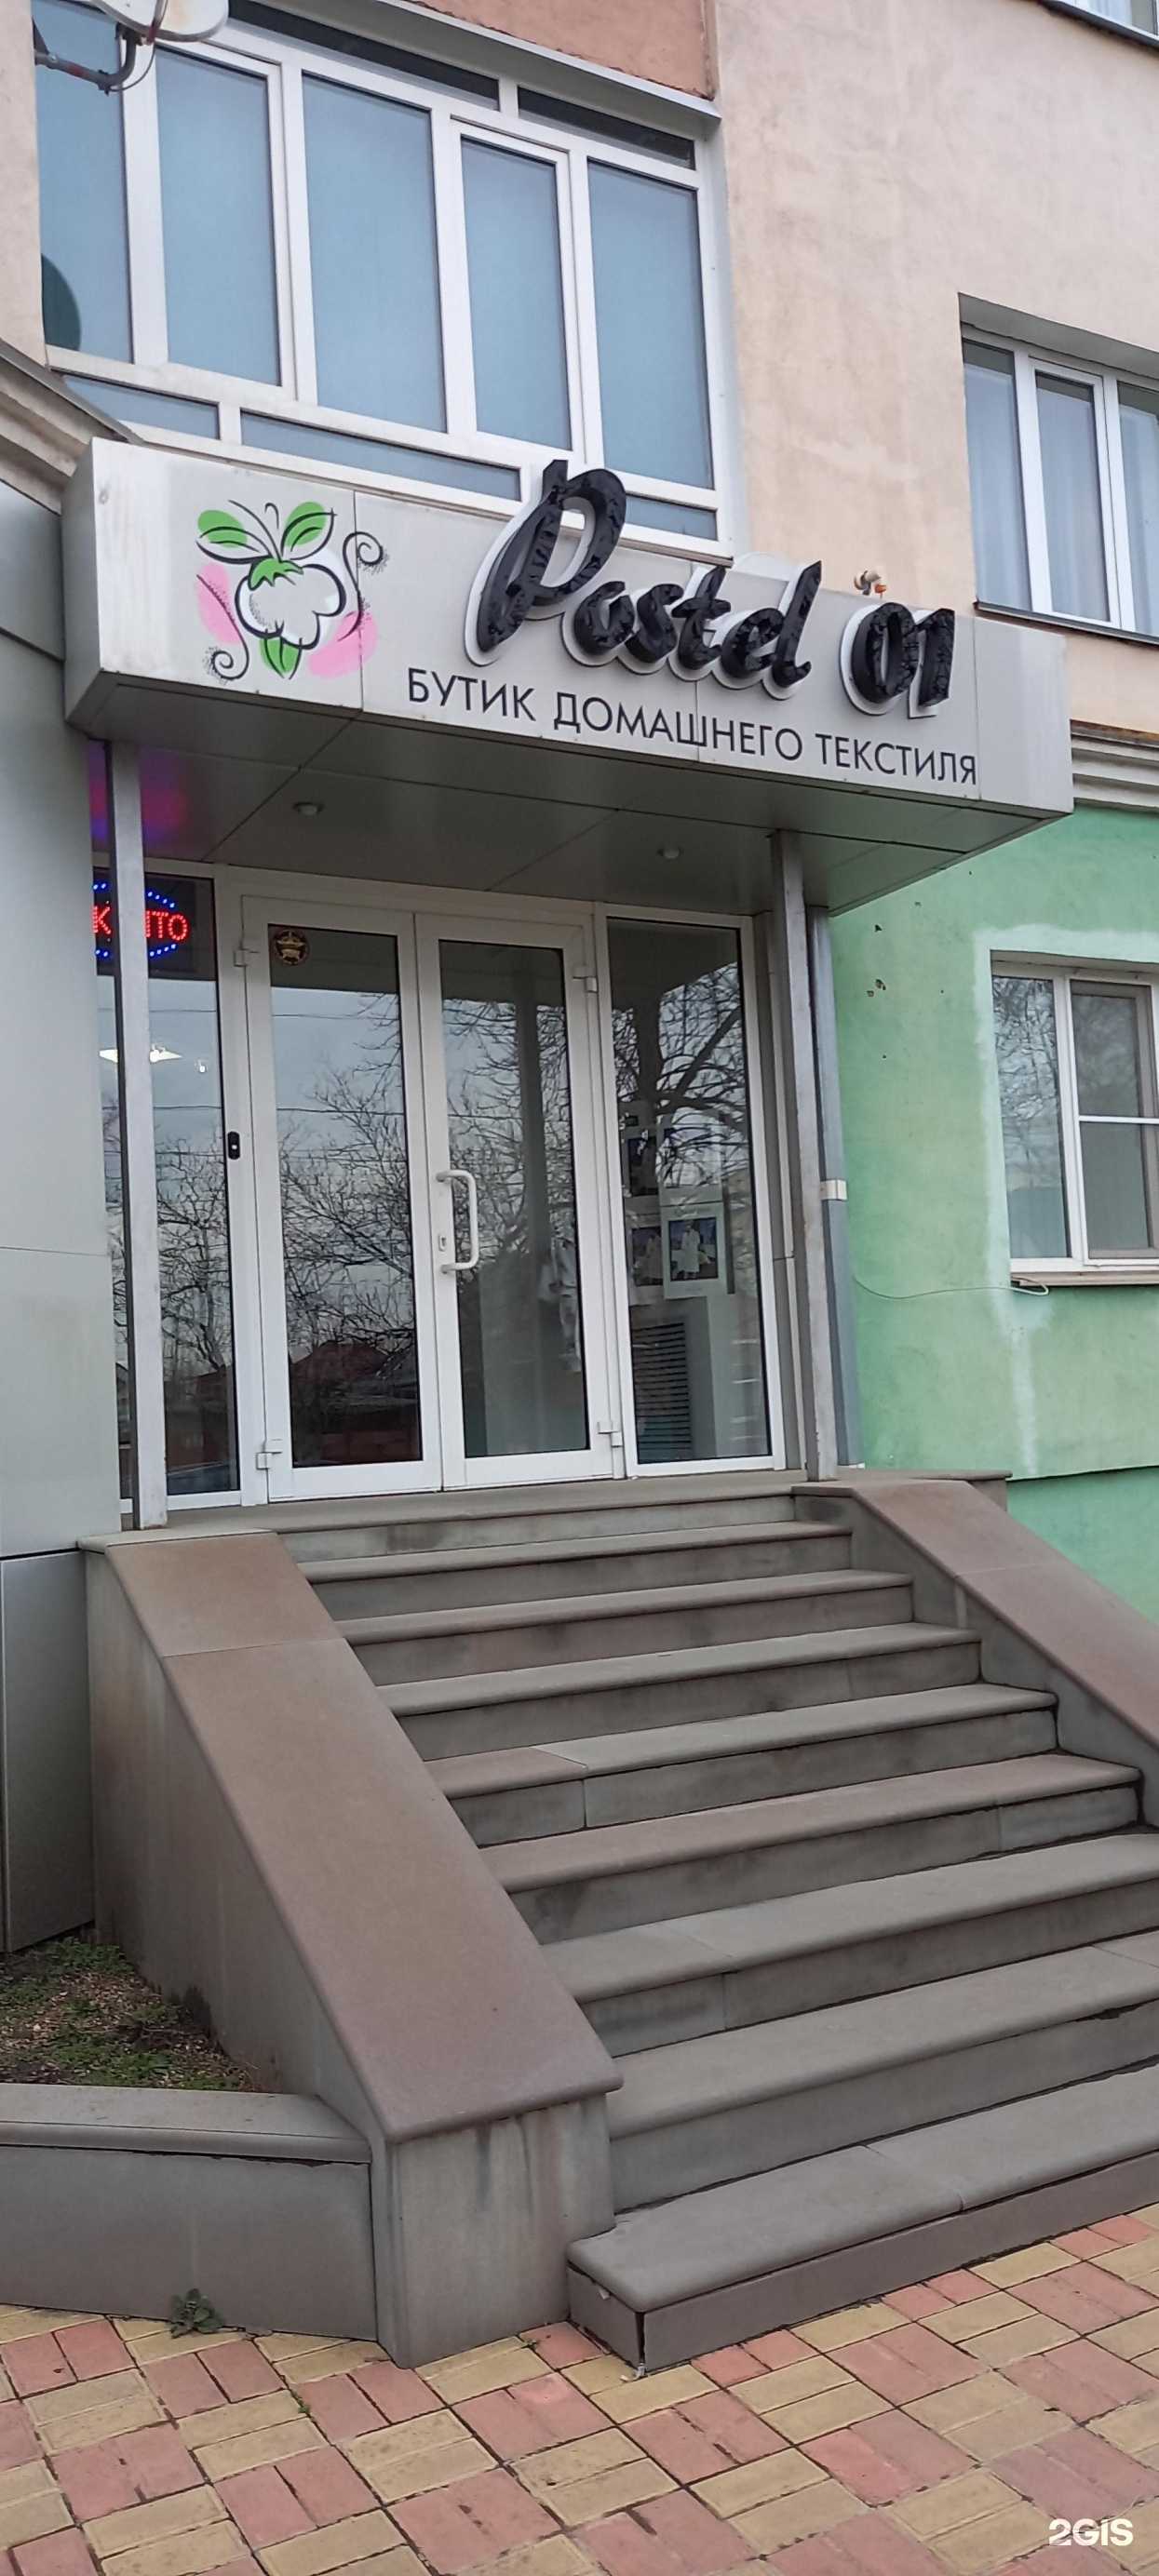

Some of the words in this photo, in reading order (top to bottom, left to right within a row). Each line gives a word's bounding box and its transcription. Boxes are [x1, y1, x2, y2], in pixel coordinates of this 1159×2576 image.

[465, 459, 822, 701] Postel
[841, 601, 955, 718] 01
[408, 667, 536, 721] БУТИК
[553, 691, 803, 761] ДОМАШНЕГО
[815, 732, 977, 786] ТЕКСТИЛЯ
